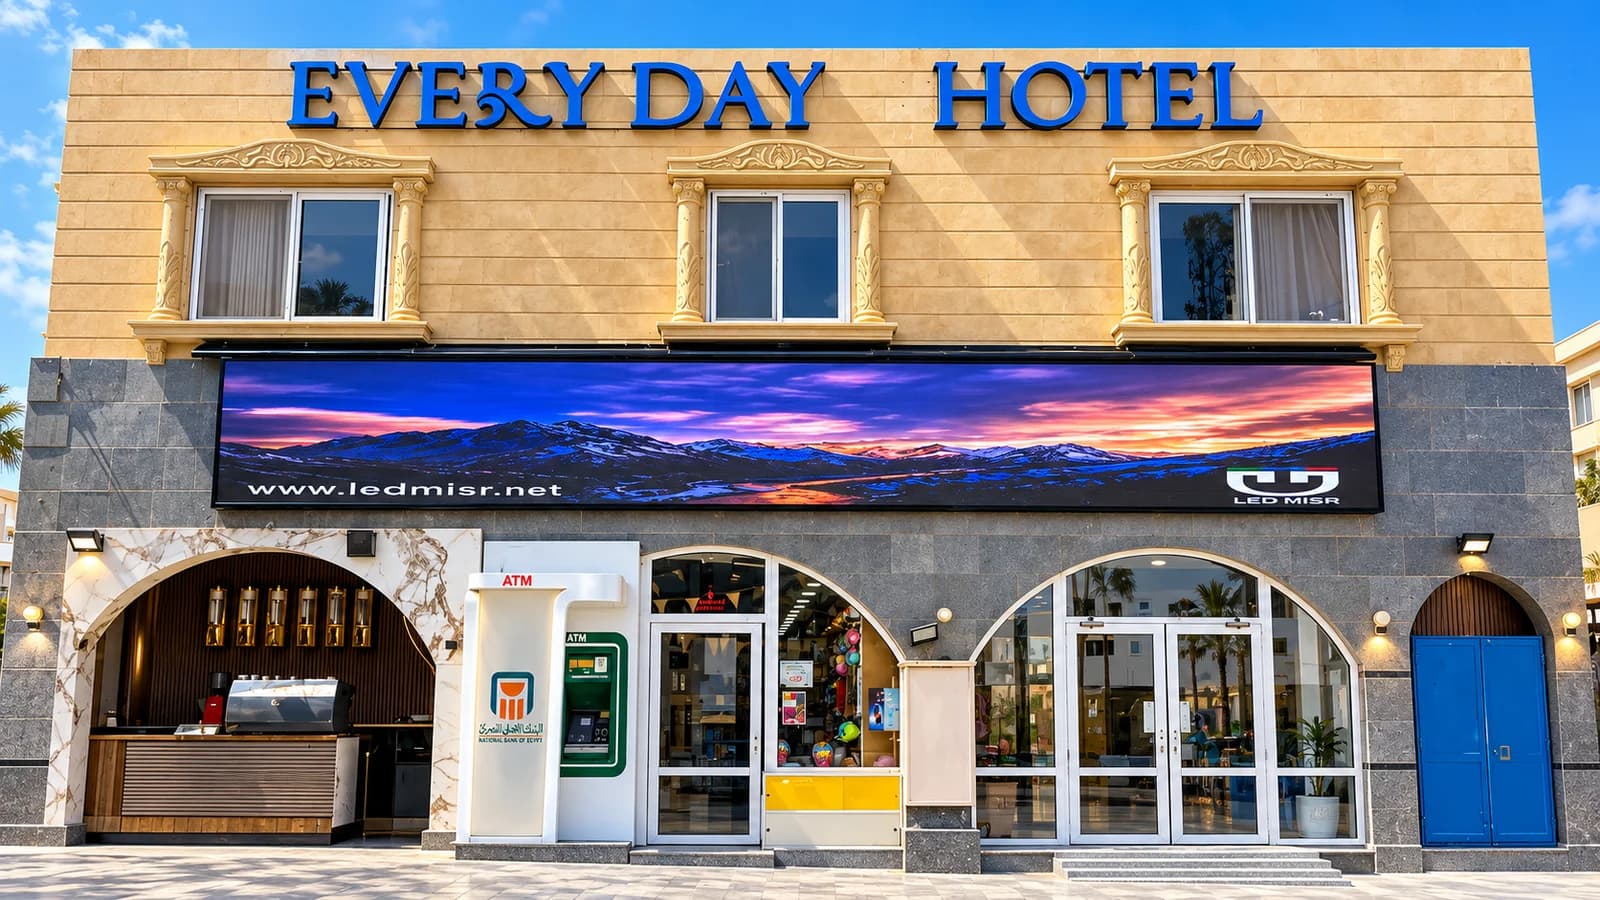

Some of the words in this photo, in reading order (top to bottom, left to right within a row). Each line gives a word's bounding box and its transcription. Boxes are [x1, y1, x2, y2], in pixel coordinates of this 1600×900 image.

[287, 61, 605, 129] EVERY
[631, 61, 826, 130] DAY
[933, 61, 1264, 130] HOTEL
[248, 482, 563, 497] www.ledmisr.net
[1233, 497, 1279, 505] LED
[1284, 497, 1340, 505] MISR
[502, 575, 533, 587] ATM
[567, 633, 587, 643] ATM
